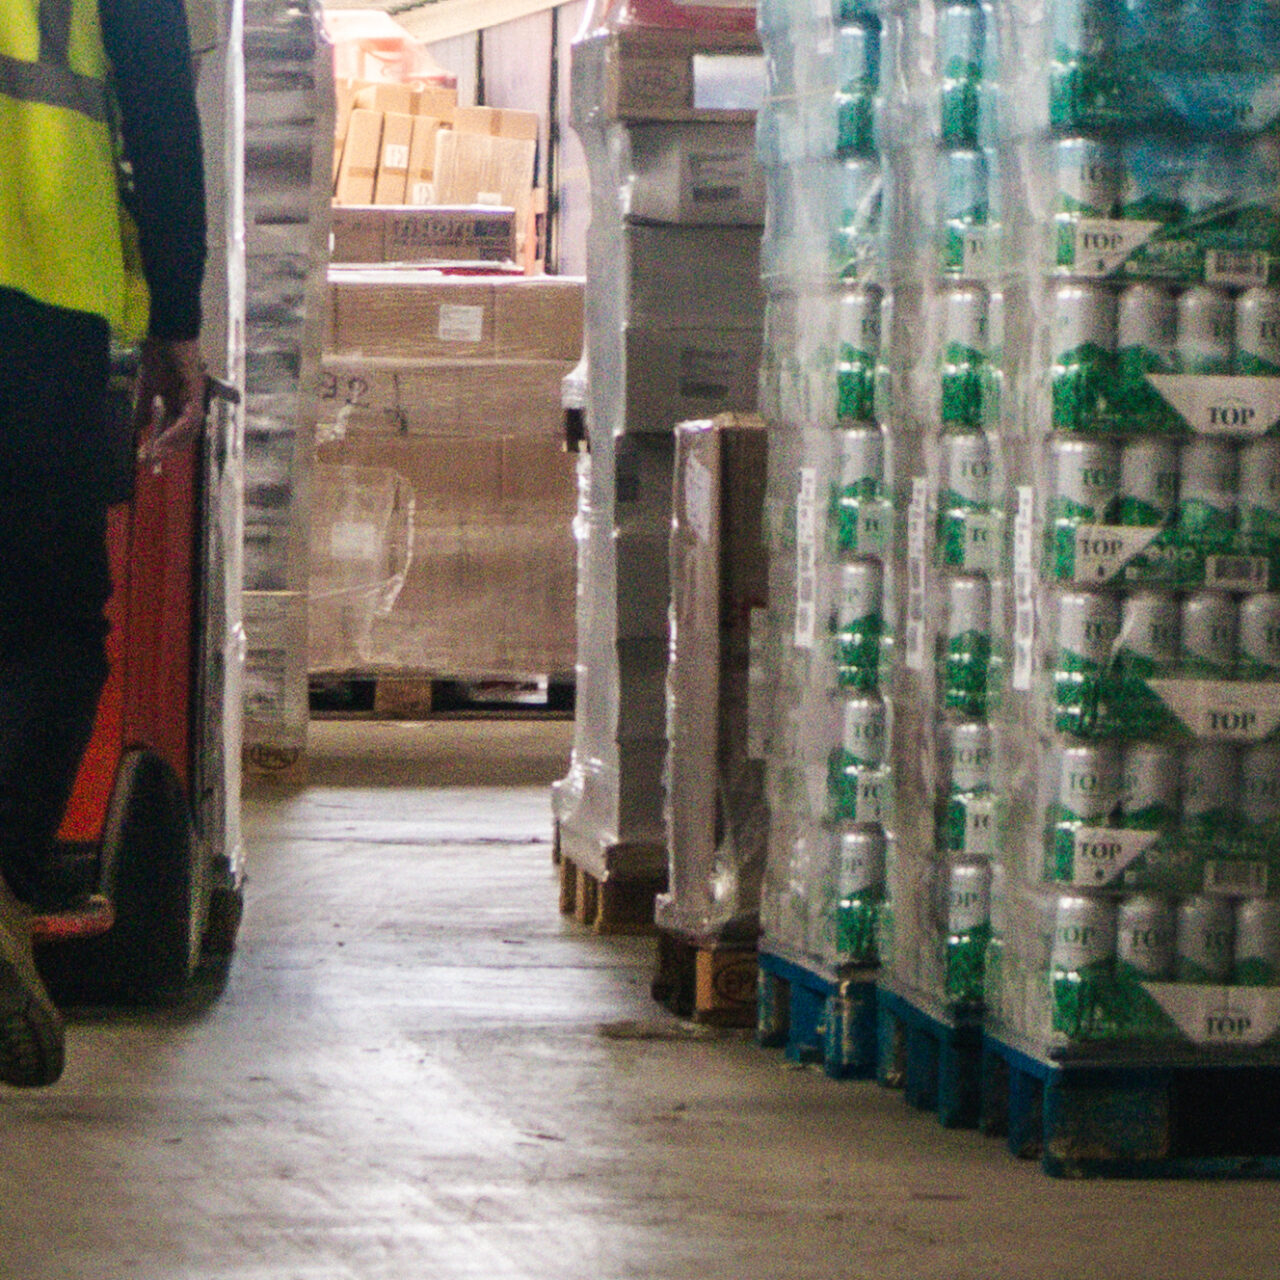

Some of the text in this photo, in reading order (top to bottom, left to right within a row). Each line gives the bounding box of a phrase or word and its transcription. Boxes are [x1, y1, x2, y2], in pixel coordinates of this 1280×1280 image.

[1081, 232, 1123, 250] TOP
[1206, 406, 1256, 426] TOP
[1080, 538, 1123, 556] TOP
[1206, 709, 1257, 730] TOP
[1080, 841, 1123, 860] TOP
[1204, 1016, 1253, 1035] TOP
